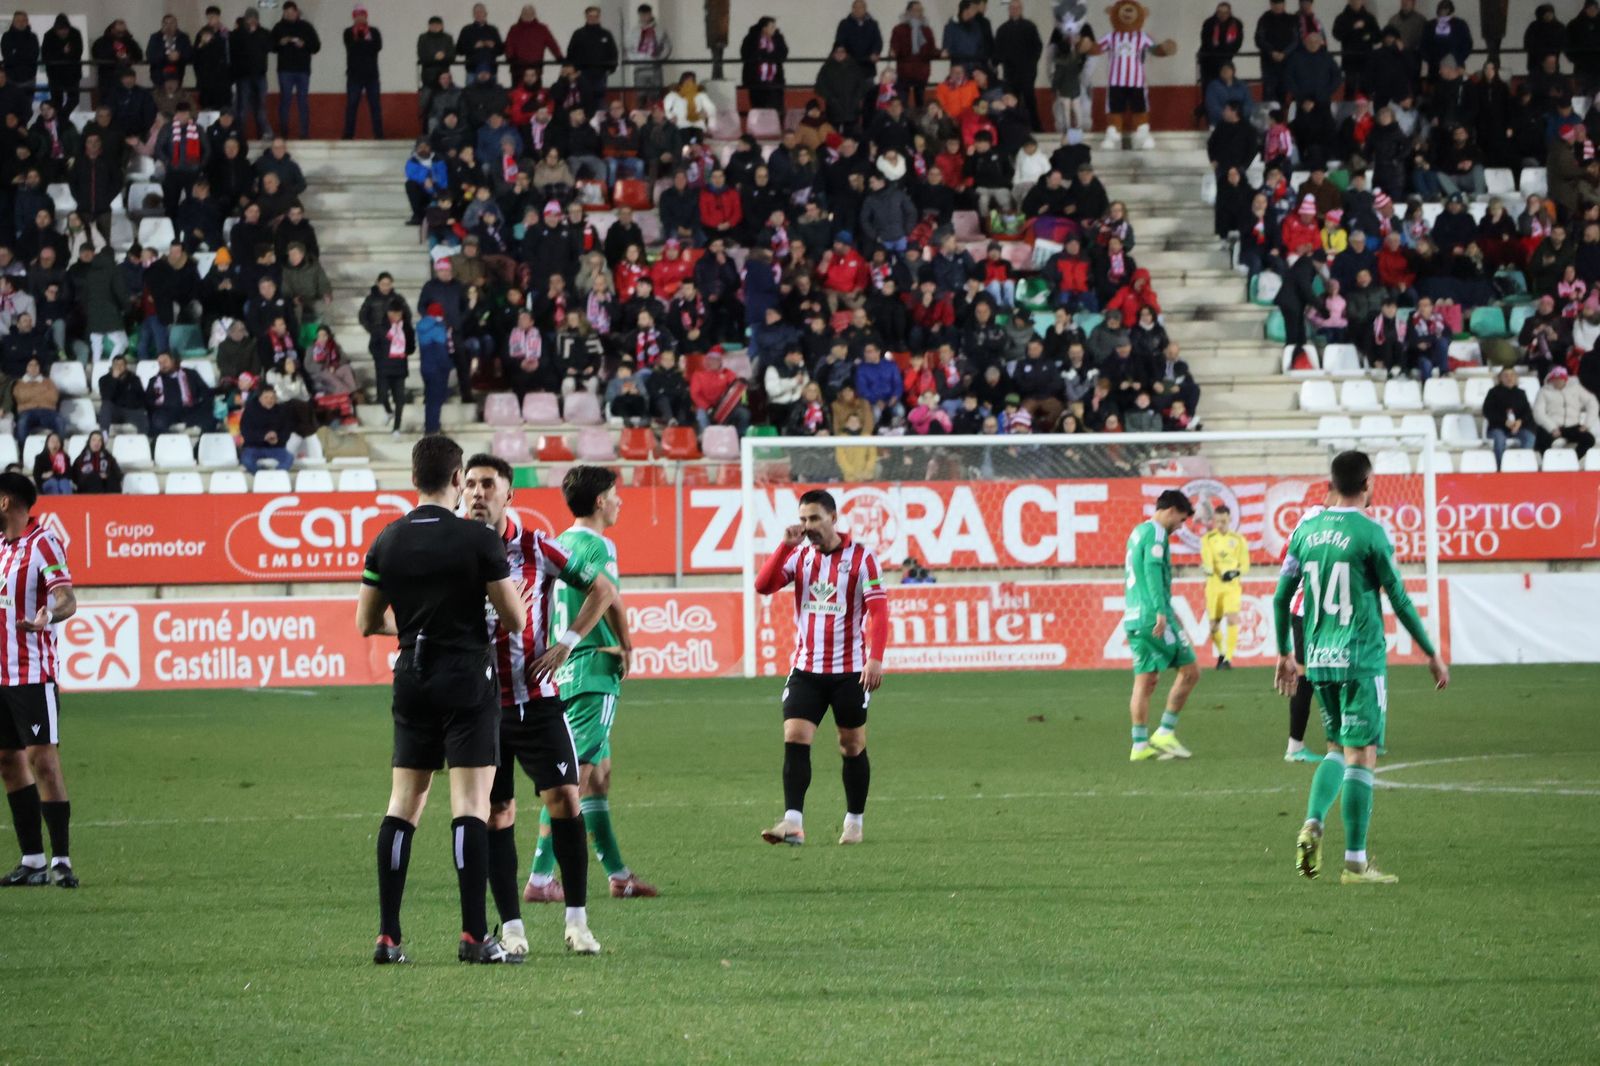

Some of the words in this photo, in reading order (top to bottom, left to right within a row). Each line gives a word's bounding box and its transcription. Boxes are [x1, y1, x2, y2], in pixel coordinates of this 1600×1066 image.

[105, 521, 154, 538] Grupo
[1002, 484, 1108, 564] CF
[106, 539, 206, 559] Leomotor
[1306, 530, 1350, 550] TEJERA
[1394, 530, 1500, 557] BERTO
[258, 552, 366, 569] EMBUTID
[1303, 561, 1353, 626] 14
[153, 610, 232, 643] Carné
[237, 611, 316, 643] Joven
[153, 647, 254, 680] Castilla
[258, 655, 275, 687] y
[280, 646, 345, 678] León
